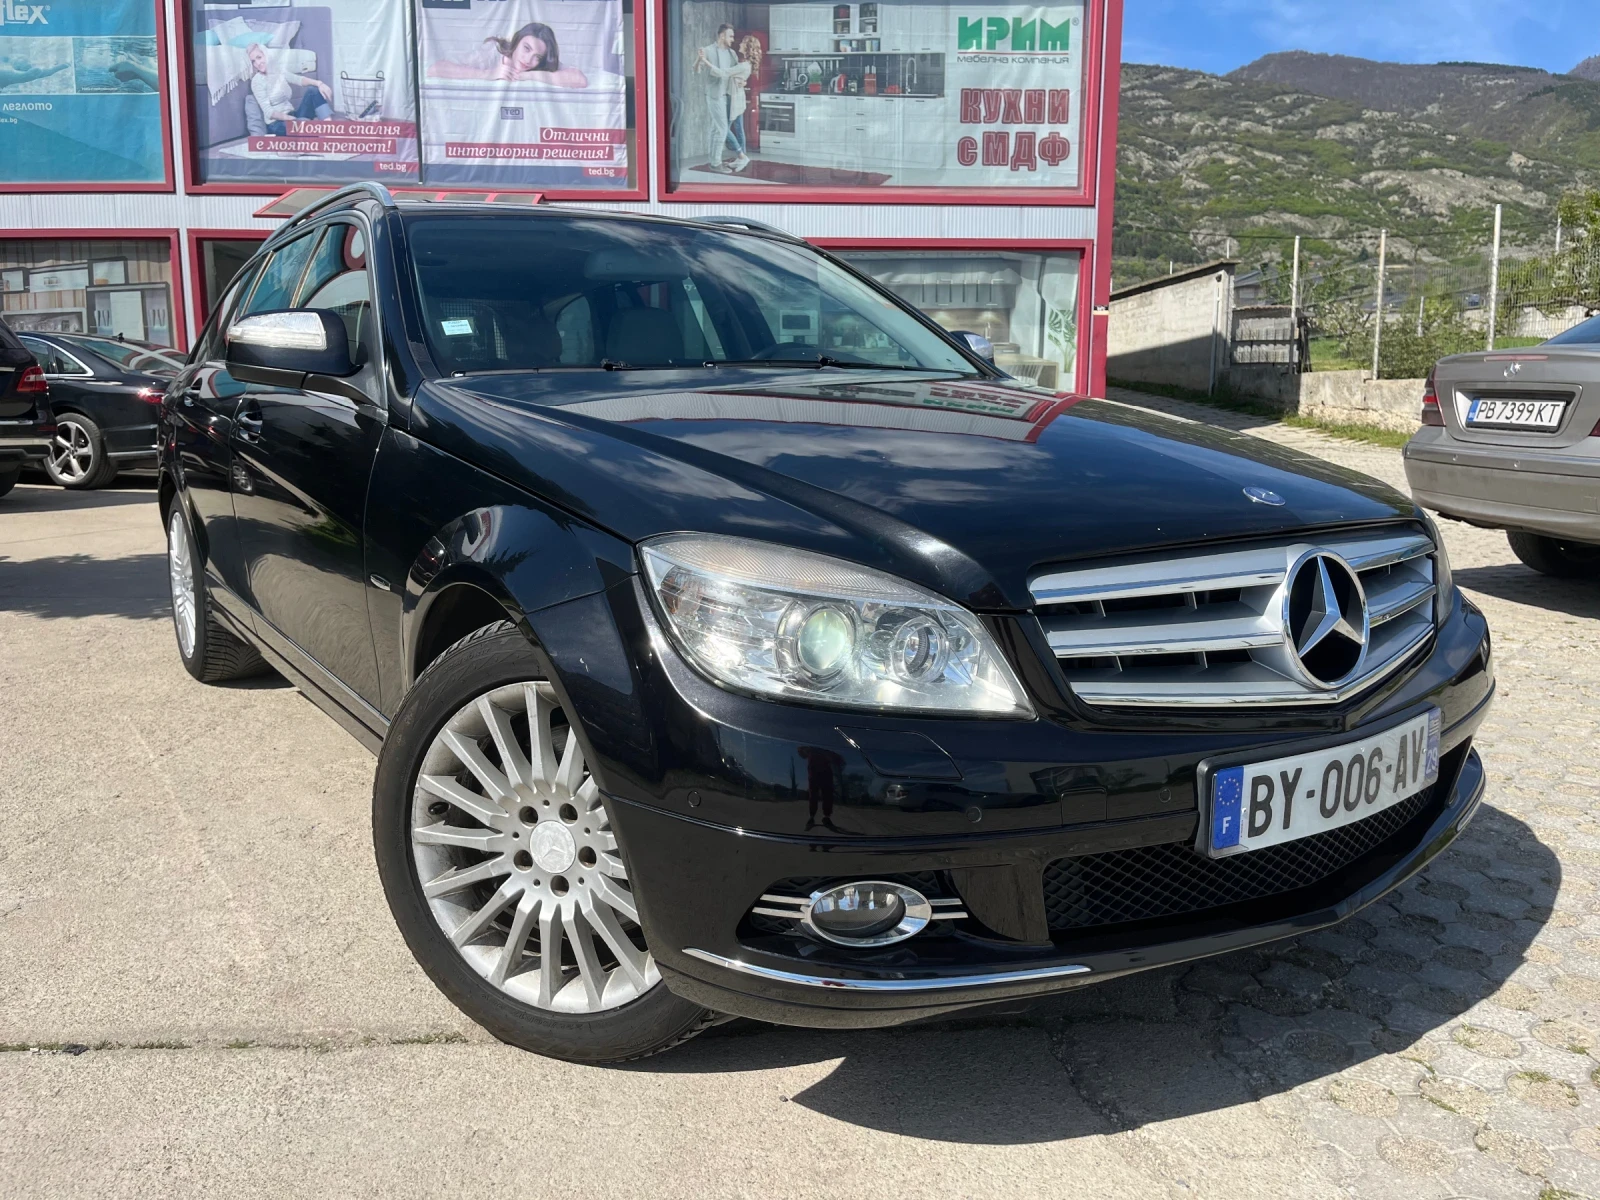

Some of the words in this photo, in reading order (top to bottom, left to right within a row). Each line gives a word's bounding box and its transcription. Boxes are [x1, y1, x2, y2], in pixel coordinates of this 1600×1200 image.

[957, 16, 1070, 51] ИРИМ
[1012, 55, 1070, 64] компания
[960, 88, 1070, 124] КУХНИ
[291, 120, 346, 135] Моята
[348, 123, 401, 136] спалня
[542, 128, 610, 142] Отлични
[256, 141, 265, 151] е
[267, 140, 319, 152] моята
[322, 139, 392, 154] крепост!
[448, 145, 539, 159] интериорни
[542, 145, 610, 160] решения!
[379, 162, 407, 173] ted.bg
[588, 167, 615, 178] ted.bg
[1247, 726, 1425, 839] BY-006-AV
[1222, 816, 1232, 835] F
